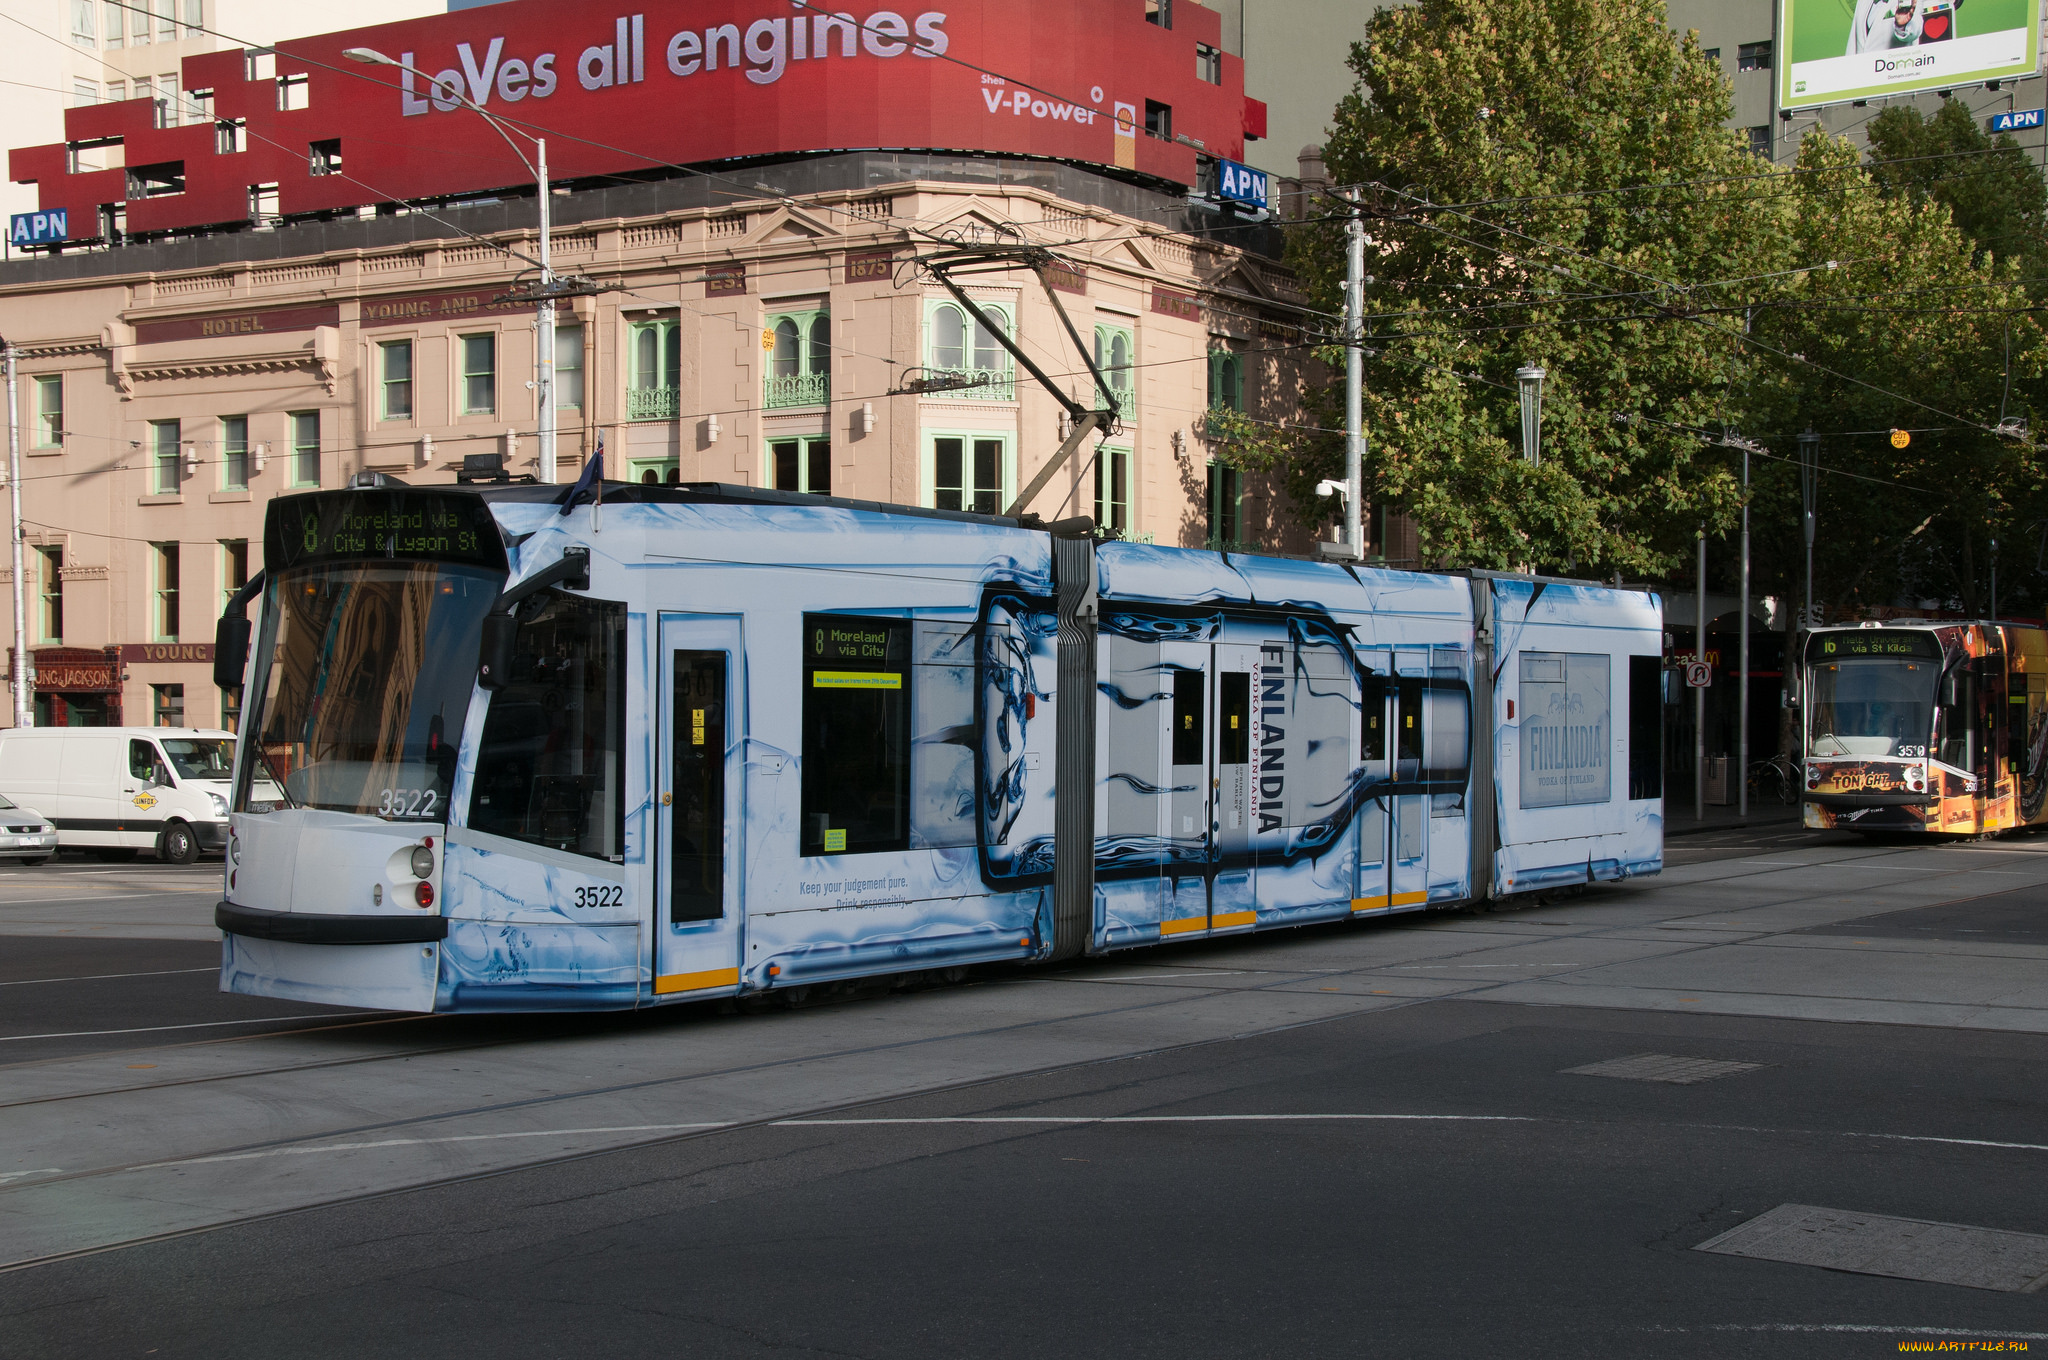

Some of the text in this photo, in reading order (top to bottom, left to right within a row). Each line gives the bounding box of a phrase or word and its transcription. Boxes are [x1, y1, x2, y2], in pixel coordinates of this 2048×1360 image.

[401, 0, 949, 117] LoVes all engines
[1874, 54, 1935, 73] Domain
[981, 88, 1098, 125] V-Power
[1998, 111, 2038, 129] APN
[1222, 165, 1266, 203] APN
[13, 212, 67, 242] APN
[850, 256, 887, 277] 1875
[366, 300, 432, 320] YOUNG
[439, 296, 478, 316] AND
[202, 316, 264, 336] HOTEL
[1259, 316, 1298, 340] JACKSON
[763, 341, 774, 350] OFF
[303, 509, 459, 552] 8 Moreland via
[333, 531, 477, 552] City & Lygon St
[142, 646, 208, 660] YOUNG
[815, 628, 886, 655] 8 Moreland
[838, 644, 884, 657] via City
[1851, 643, 1912, 653] via St Kilda
[35, 669, 58, 685] UNG
[61, 668, 111, 688] JACKSON
[1252, 716, 1258, 741] OF
[1258, 645, 1285, 835] FINLANDIA
[1530, 725, 1602, 771] FINLANDIA
[1251, 748, 1259, 817] FINLAND
[1538, 774, 1595, 786] VODKA OF FINLAND
[377, 788, 438, 817] 3522
[574, 885, 624, 909] 3522
[799, 877, 908, 897] Keep your judgement pure.
[836, 894, 909, 912] Drink responsibly.
